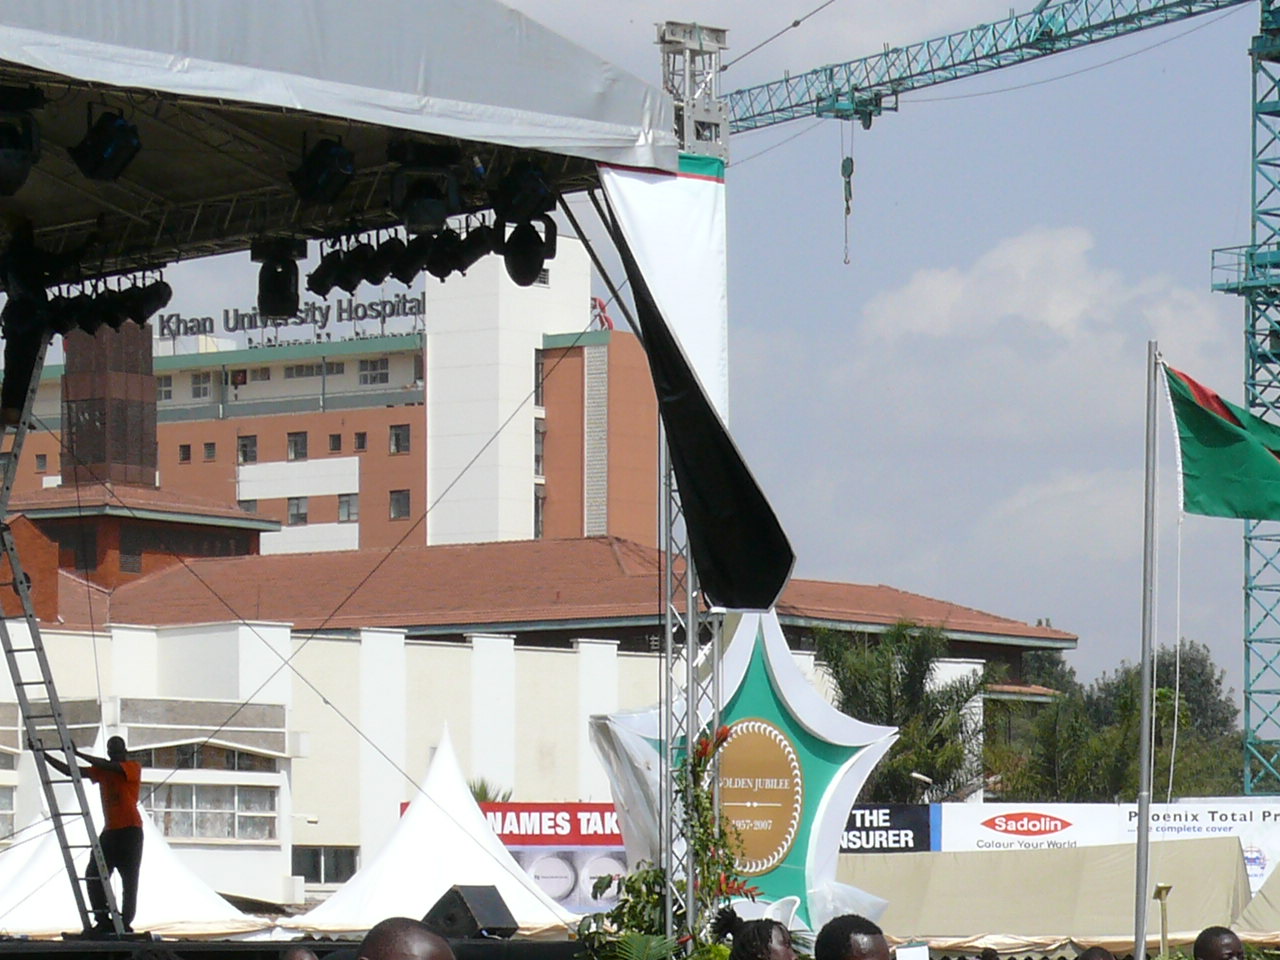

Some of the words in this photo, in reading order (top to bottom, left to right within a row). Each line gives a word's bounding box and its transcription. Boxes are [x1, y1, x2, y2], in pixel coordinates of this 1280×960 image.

[159, 313, 214, 337] Khan
[223, 302, 331, 333] Univsity
[337, 292, 426, 324] Hospital
[753, 778, 790, 792] JUBILEE
[486, 811, 570, 835] NAMES
[577, 811, 620, 834] TAK
[852, 809, 891, 828] THE
[1128, 810, 1199, 822] Poenix
[1208, 811, 1253, 822] Total
[994, 817, 1062, 831] Sadolin
[1155, 825, 1203, 834] complete
[840, 830, 915, 849] NSURER
[976, 840, 1014, 849] Colour
[1018, 840, 1044, 849] Your
[1047, 840, 1077, 848] World
